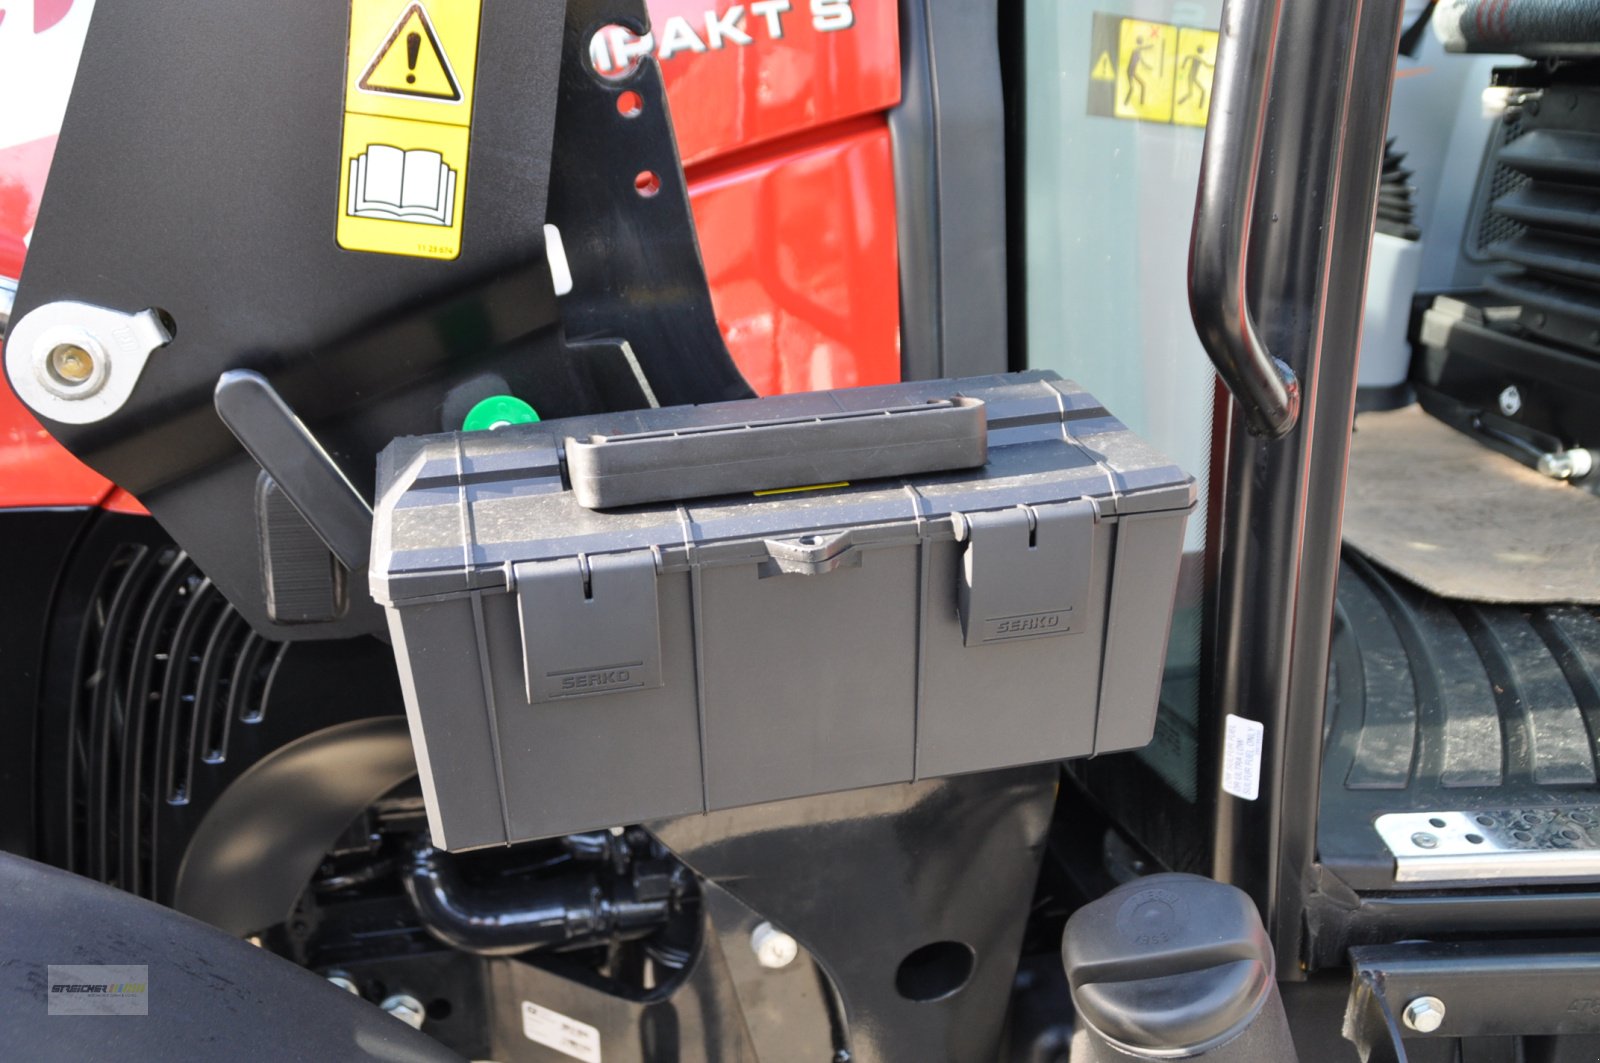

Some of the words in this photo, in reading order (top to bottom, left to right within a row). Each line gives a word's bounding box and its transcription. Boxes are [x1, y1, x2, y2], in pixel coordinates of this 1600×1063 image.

[811, 0, 855, 31] S
[996, 615, 1059, 634] SERKO
[561, 671, 630, 690] SERKO
